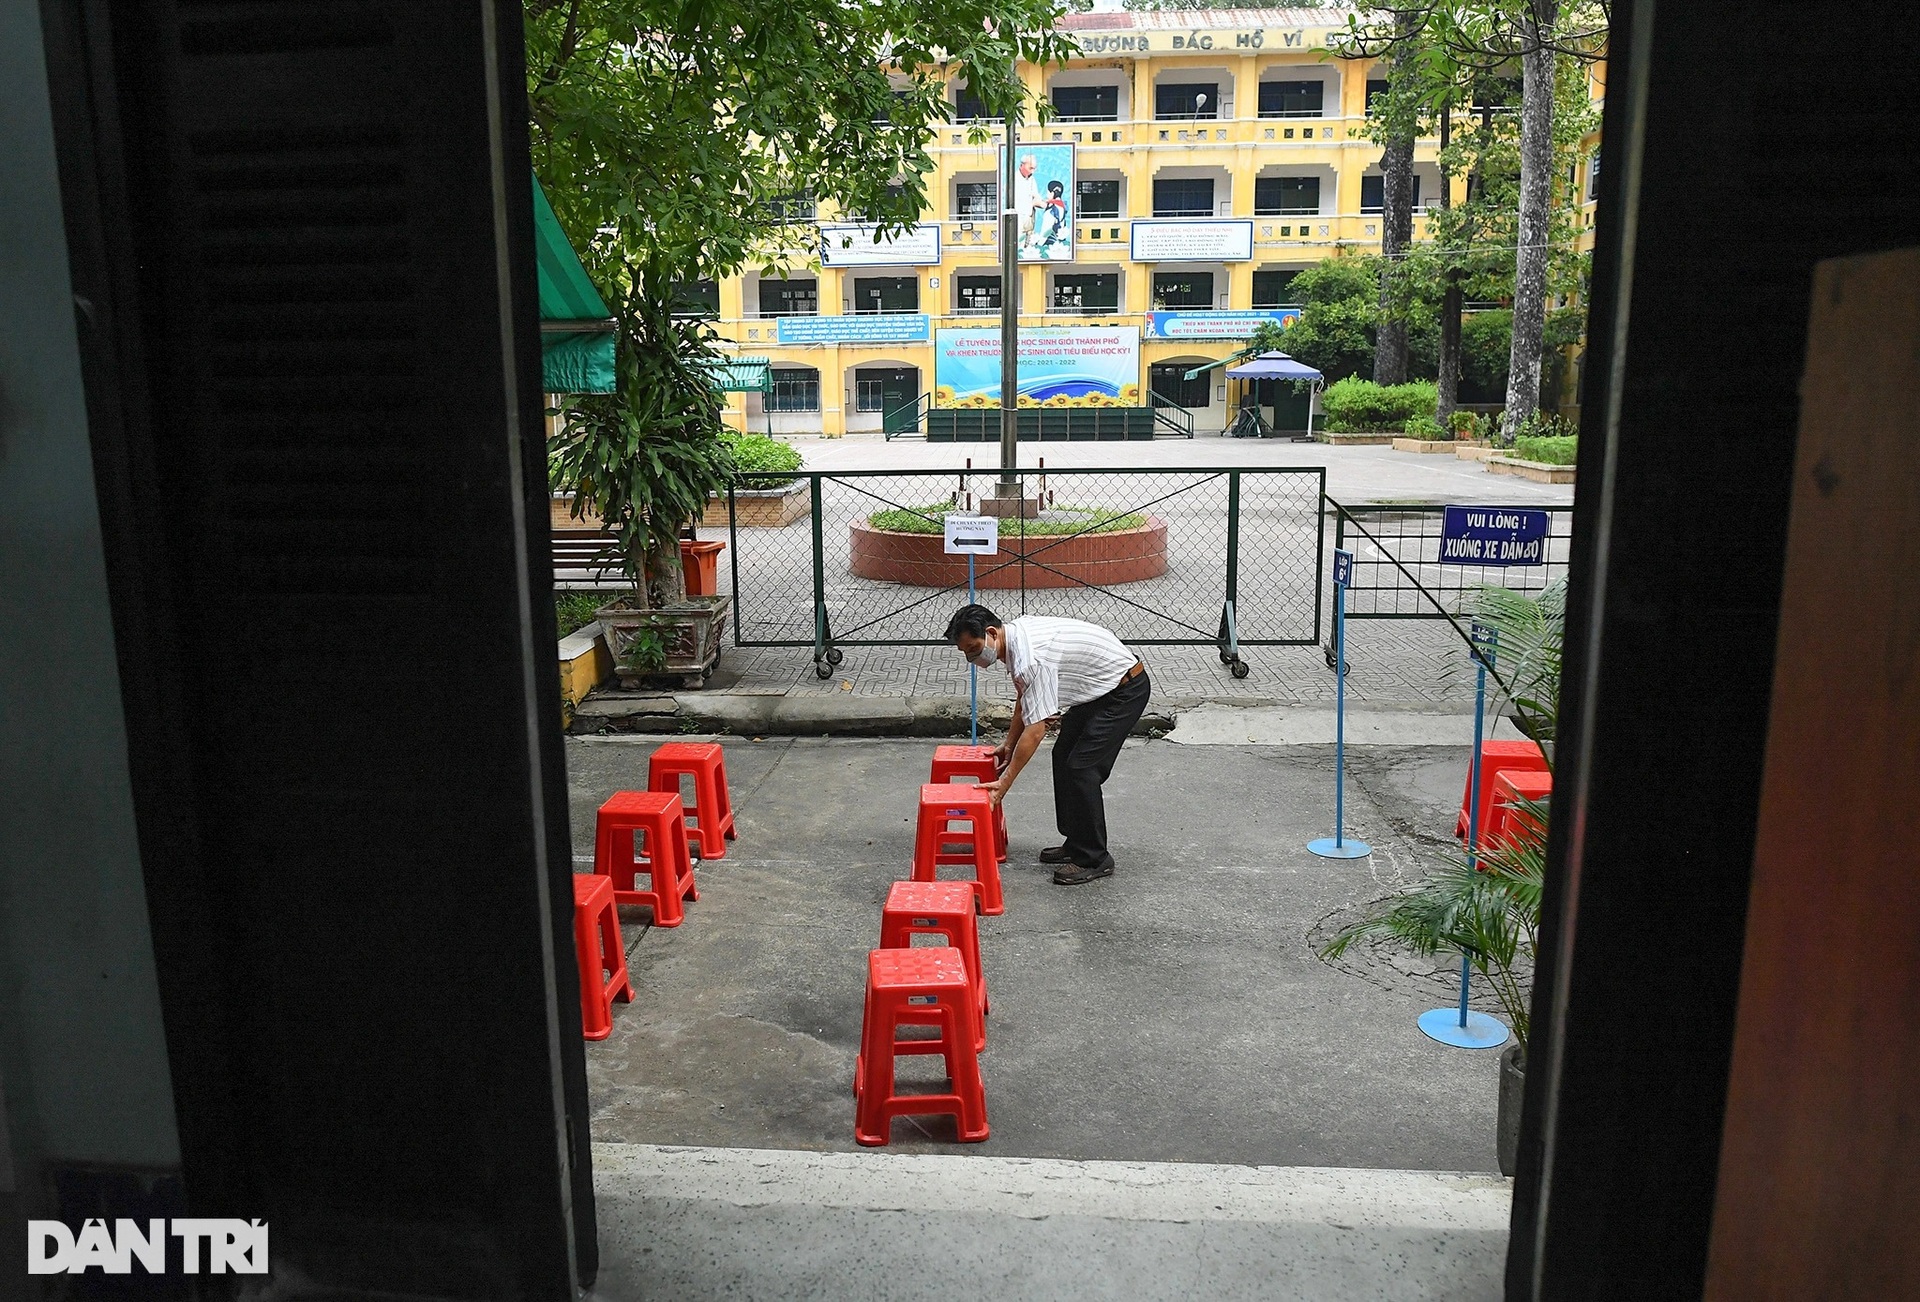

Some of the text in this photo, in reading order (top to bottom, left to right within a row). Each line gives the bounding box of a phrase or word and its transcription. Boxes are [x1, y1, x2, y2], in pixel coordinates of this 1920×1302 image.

[1172, 30, 1214, 50] BÁC
[1236, 28, 1264, 48] HỒ
[1283, 28, 1302, 46] VĨ
[955, 338, 964, 346] LỄ
[1103, 336, 1120, 344] PHỐ
[1082, 346, 1099, 354] BIỂU
[1118, 346, 1127, 354] KỲ
[1467, 512, 1527, 529] VUI LÒNG !
[1444, 532, 1481, 558] XUỐNG
[1483, 540, 1498, 559] XE
[1501, 532, 1523, 559] DẪN
